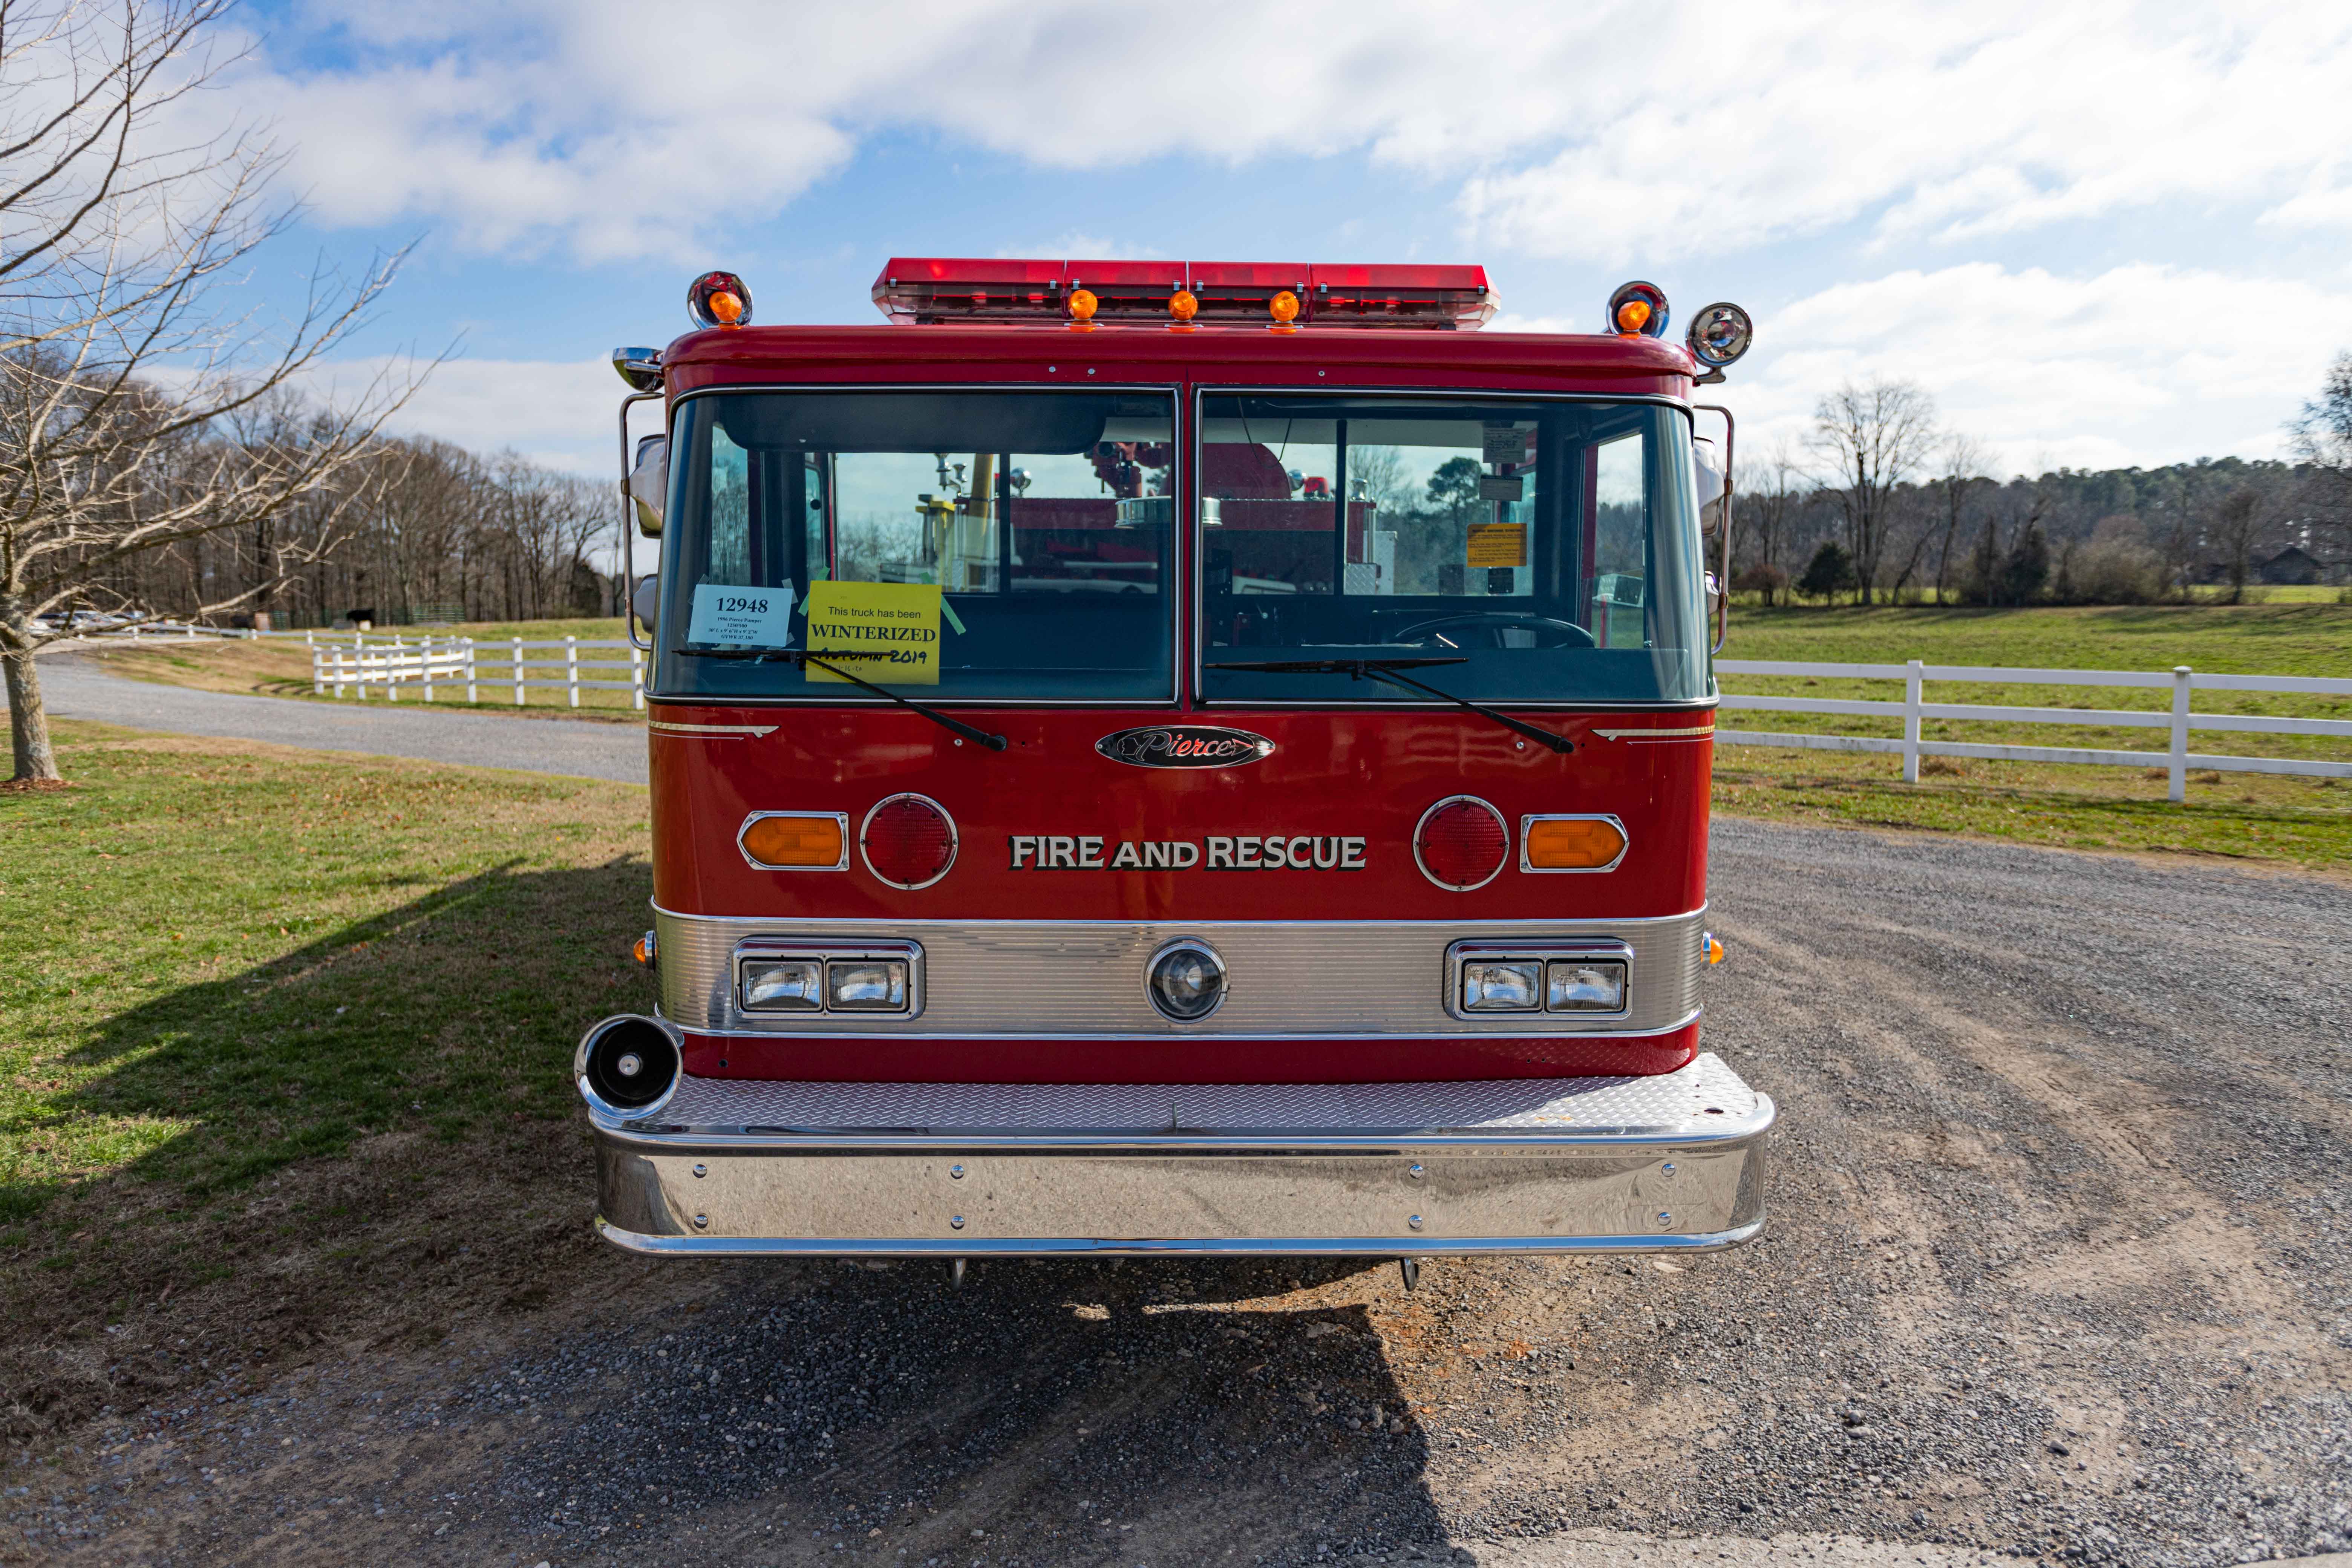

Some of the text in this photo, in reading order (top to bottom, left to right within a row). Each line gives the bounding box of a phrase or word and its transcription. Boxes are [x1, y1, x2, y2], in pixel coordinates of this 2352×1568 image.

[716, 597, 768, 613] 12948
[828, 606, 921, 619] This truck has been
[811, 624, 936, 642] WINTERIZED
[890, 649, 927, 664] 2019
[1135, 730, 1233, 762] Pierce
[1008, 835, 1367, 869] FIRE AND RESCUE
